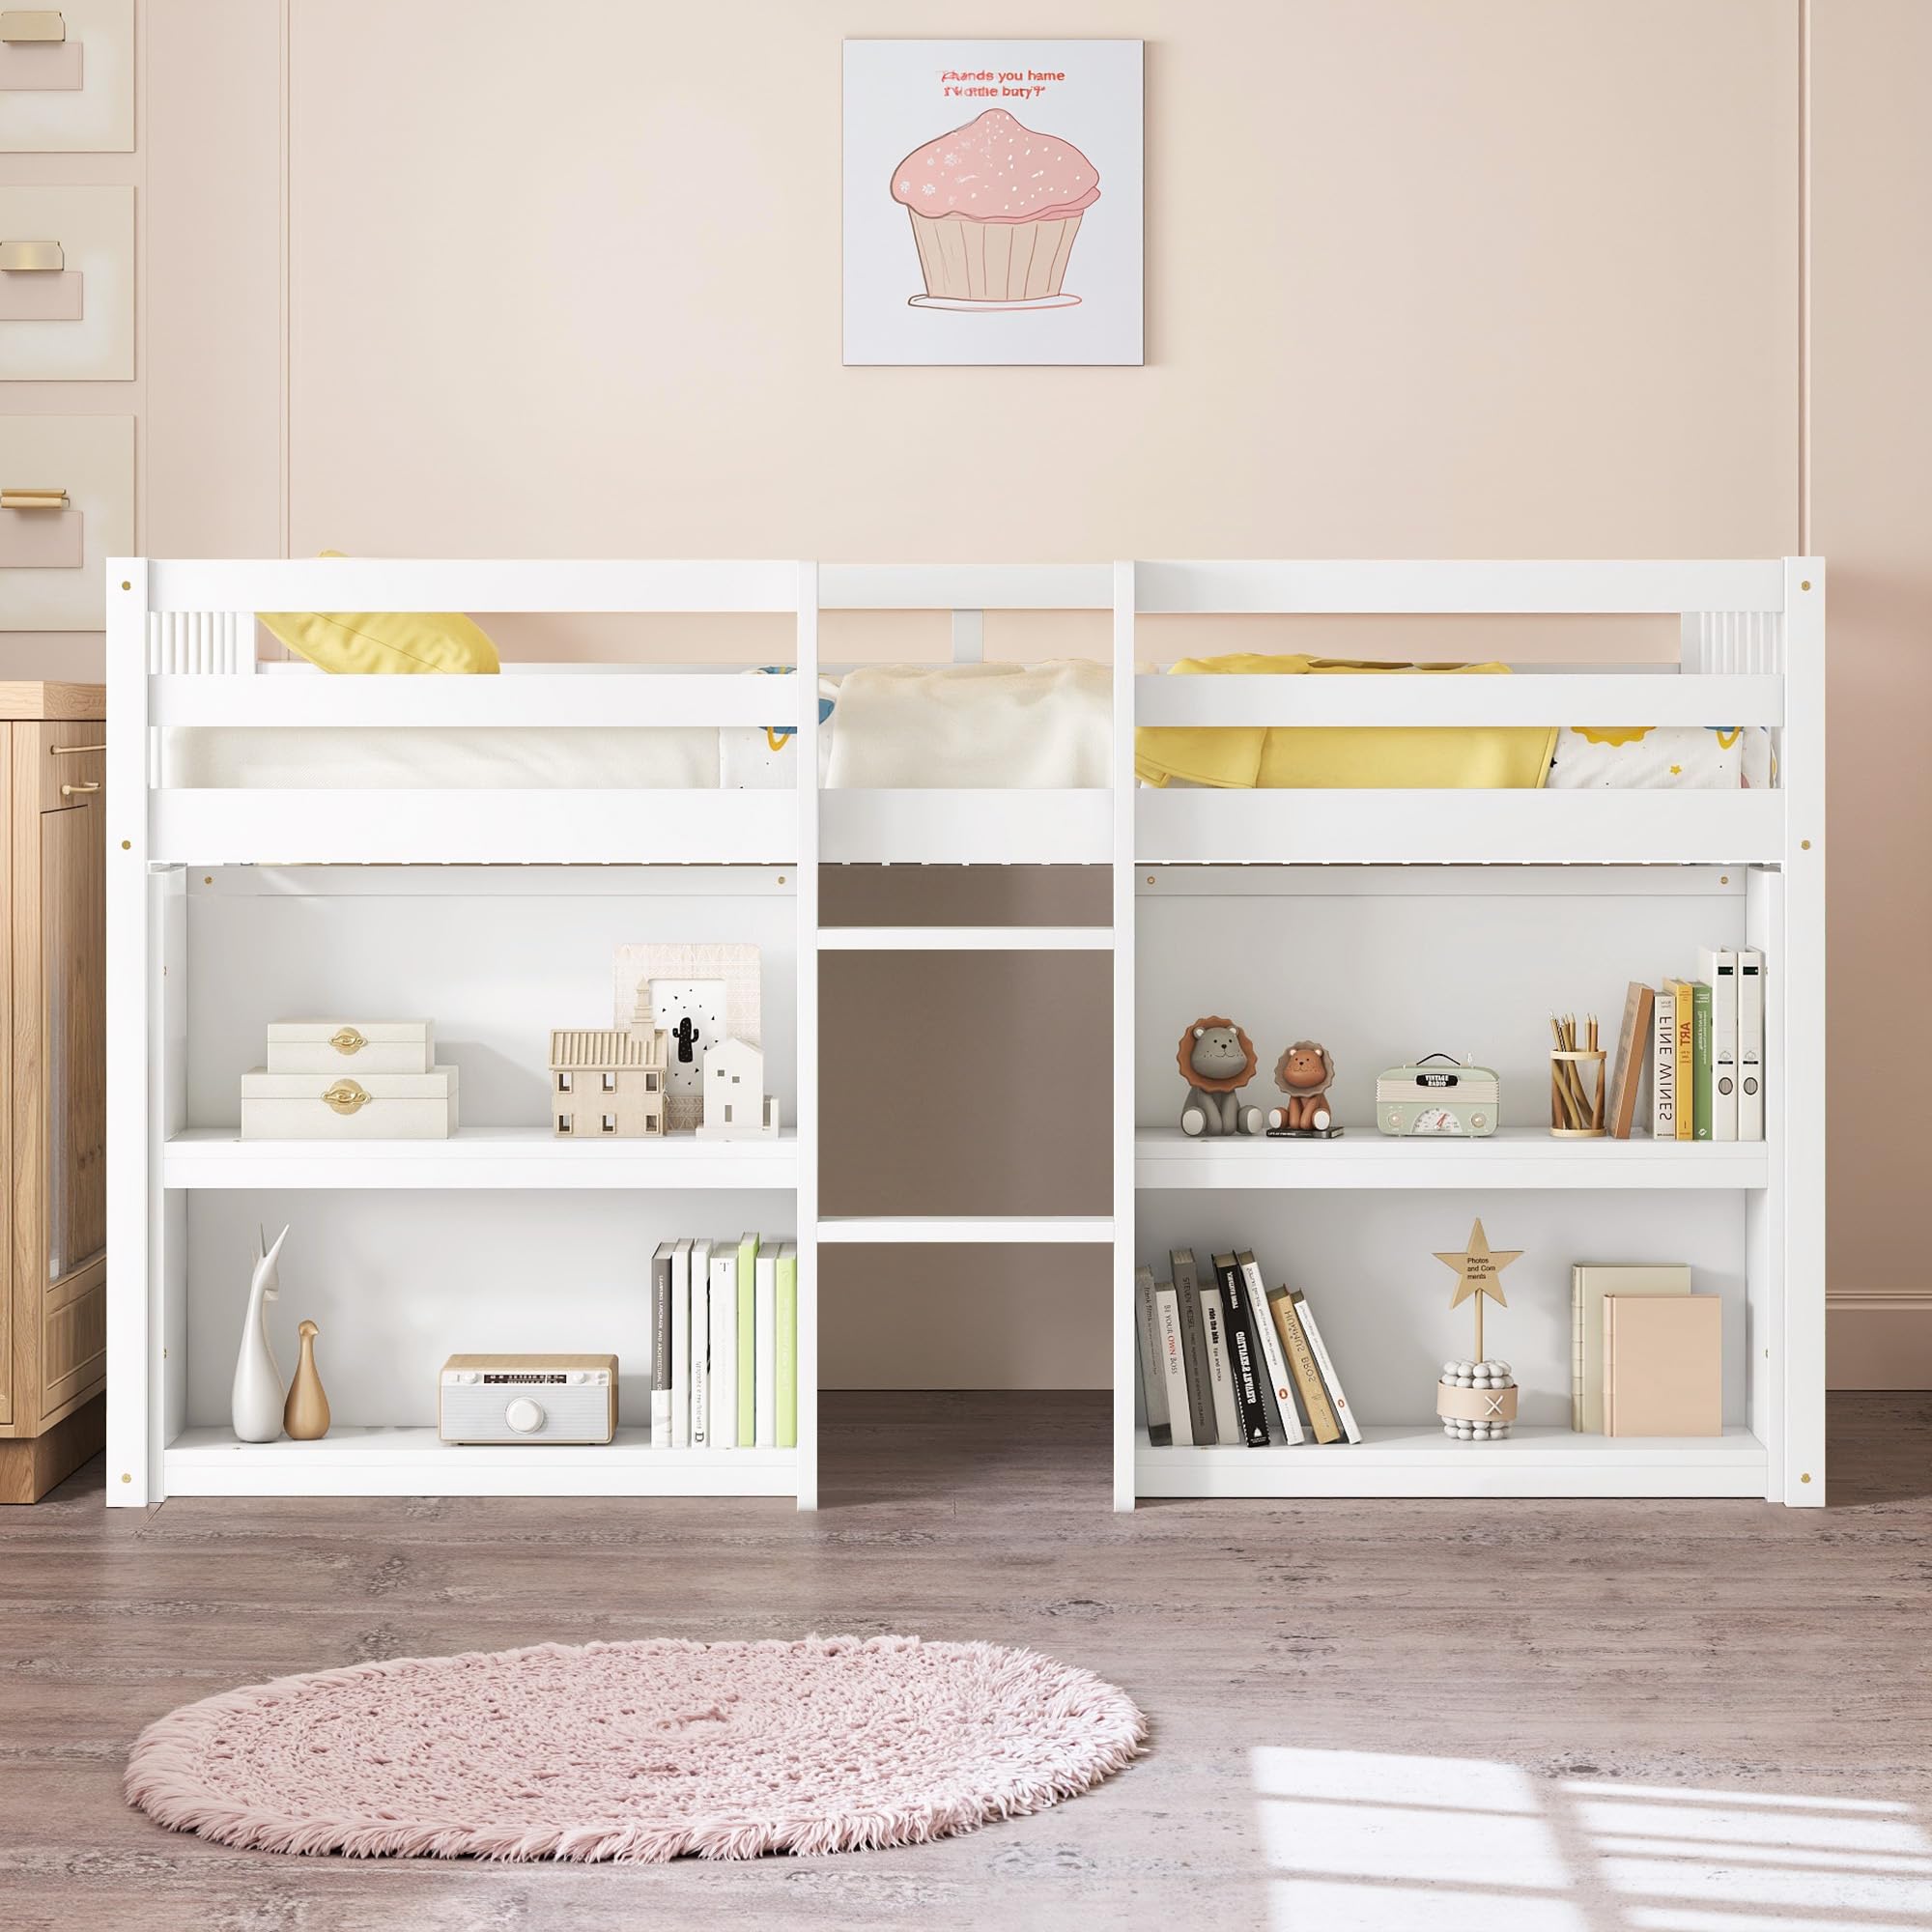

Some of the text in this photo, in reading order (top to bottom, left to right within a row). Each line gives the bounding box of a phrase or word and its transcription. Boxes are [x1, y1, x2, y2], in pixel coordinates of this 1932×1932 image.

[998, 72, 1023, 83] you
[1165, 1315, 1174, 1335] YOUR
[1167, 1335, 1177, 1355] OWN
